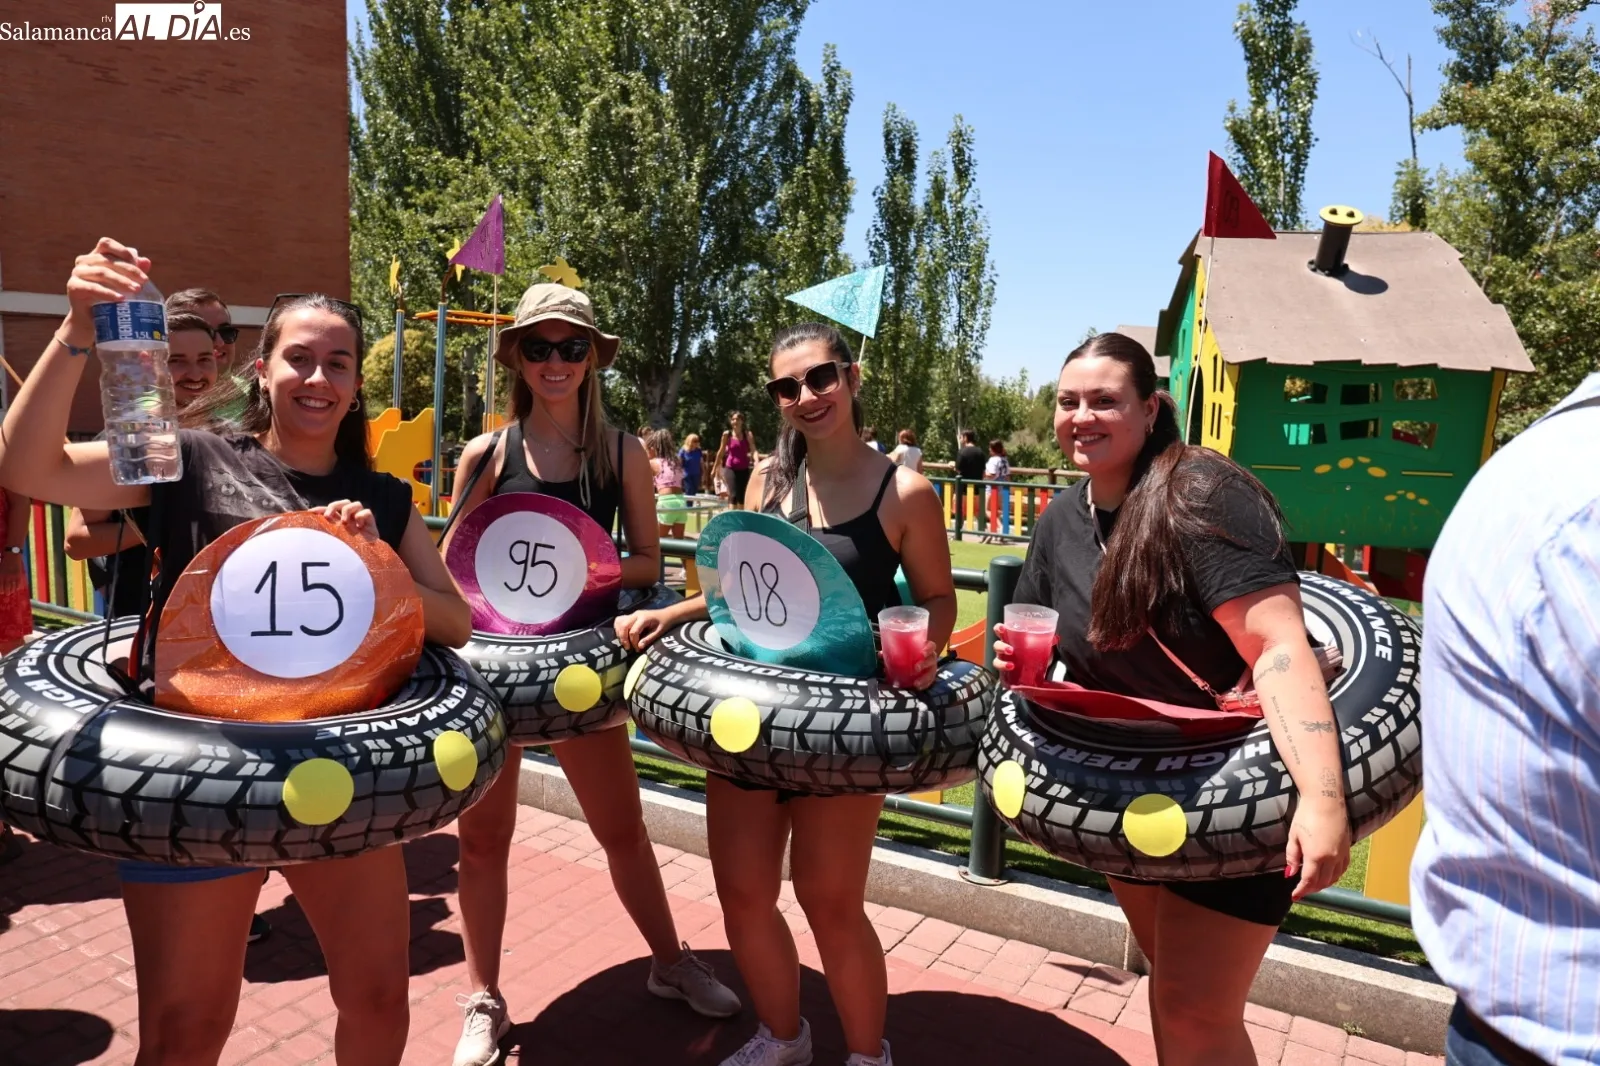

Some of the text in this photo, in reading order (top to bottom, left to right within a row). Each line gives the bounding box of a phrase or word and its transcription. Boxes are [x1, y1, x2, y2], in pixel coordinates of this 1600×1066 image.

[250, 560, 345, 637] 15
[504, 539, 558, 598] 95
[739, 560, 787, 627] 08
[481, 641, 568, 656] HIGH
[1297, 570, 1393, 662] ORMANCE
[1000, 688, 1271, 772] HIGH PERFORMA
